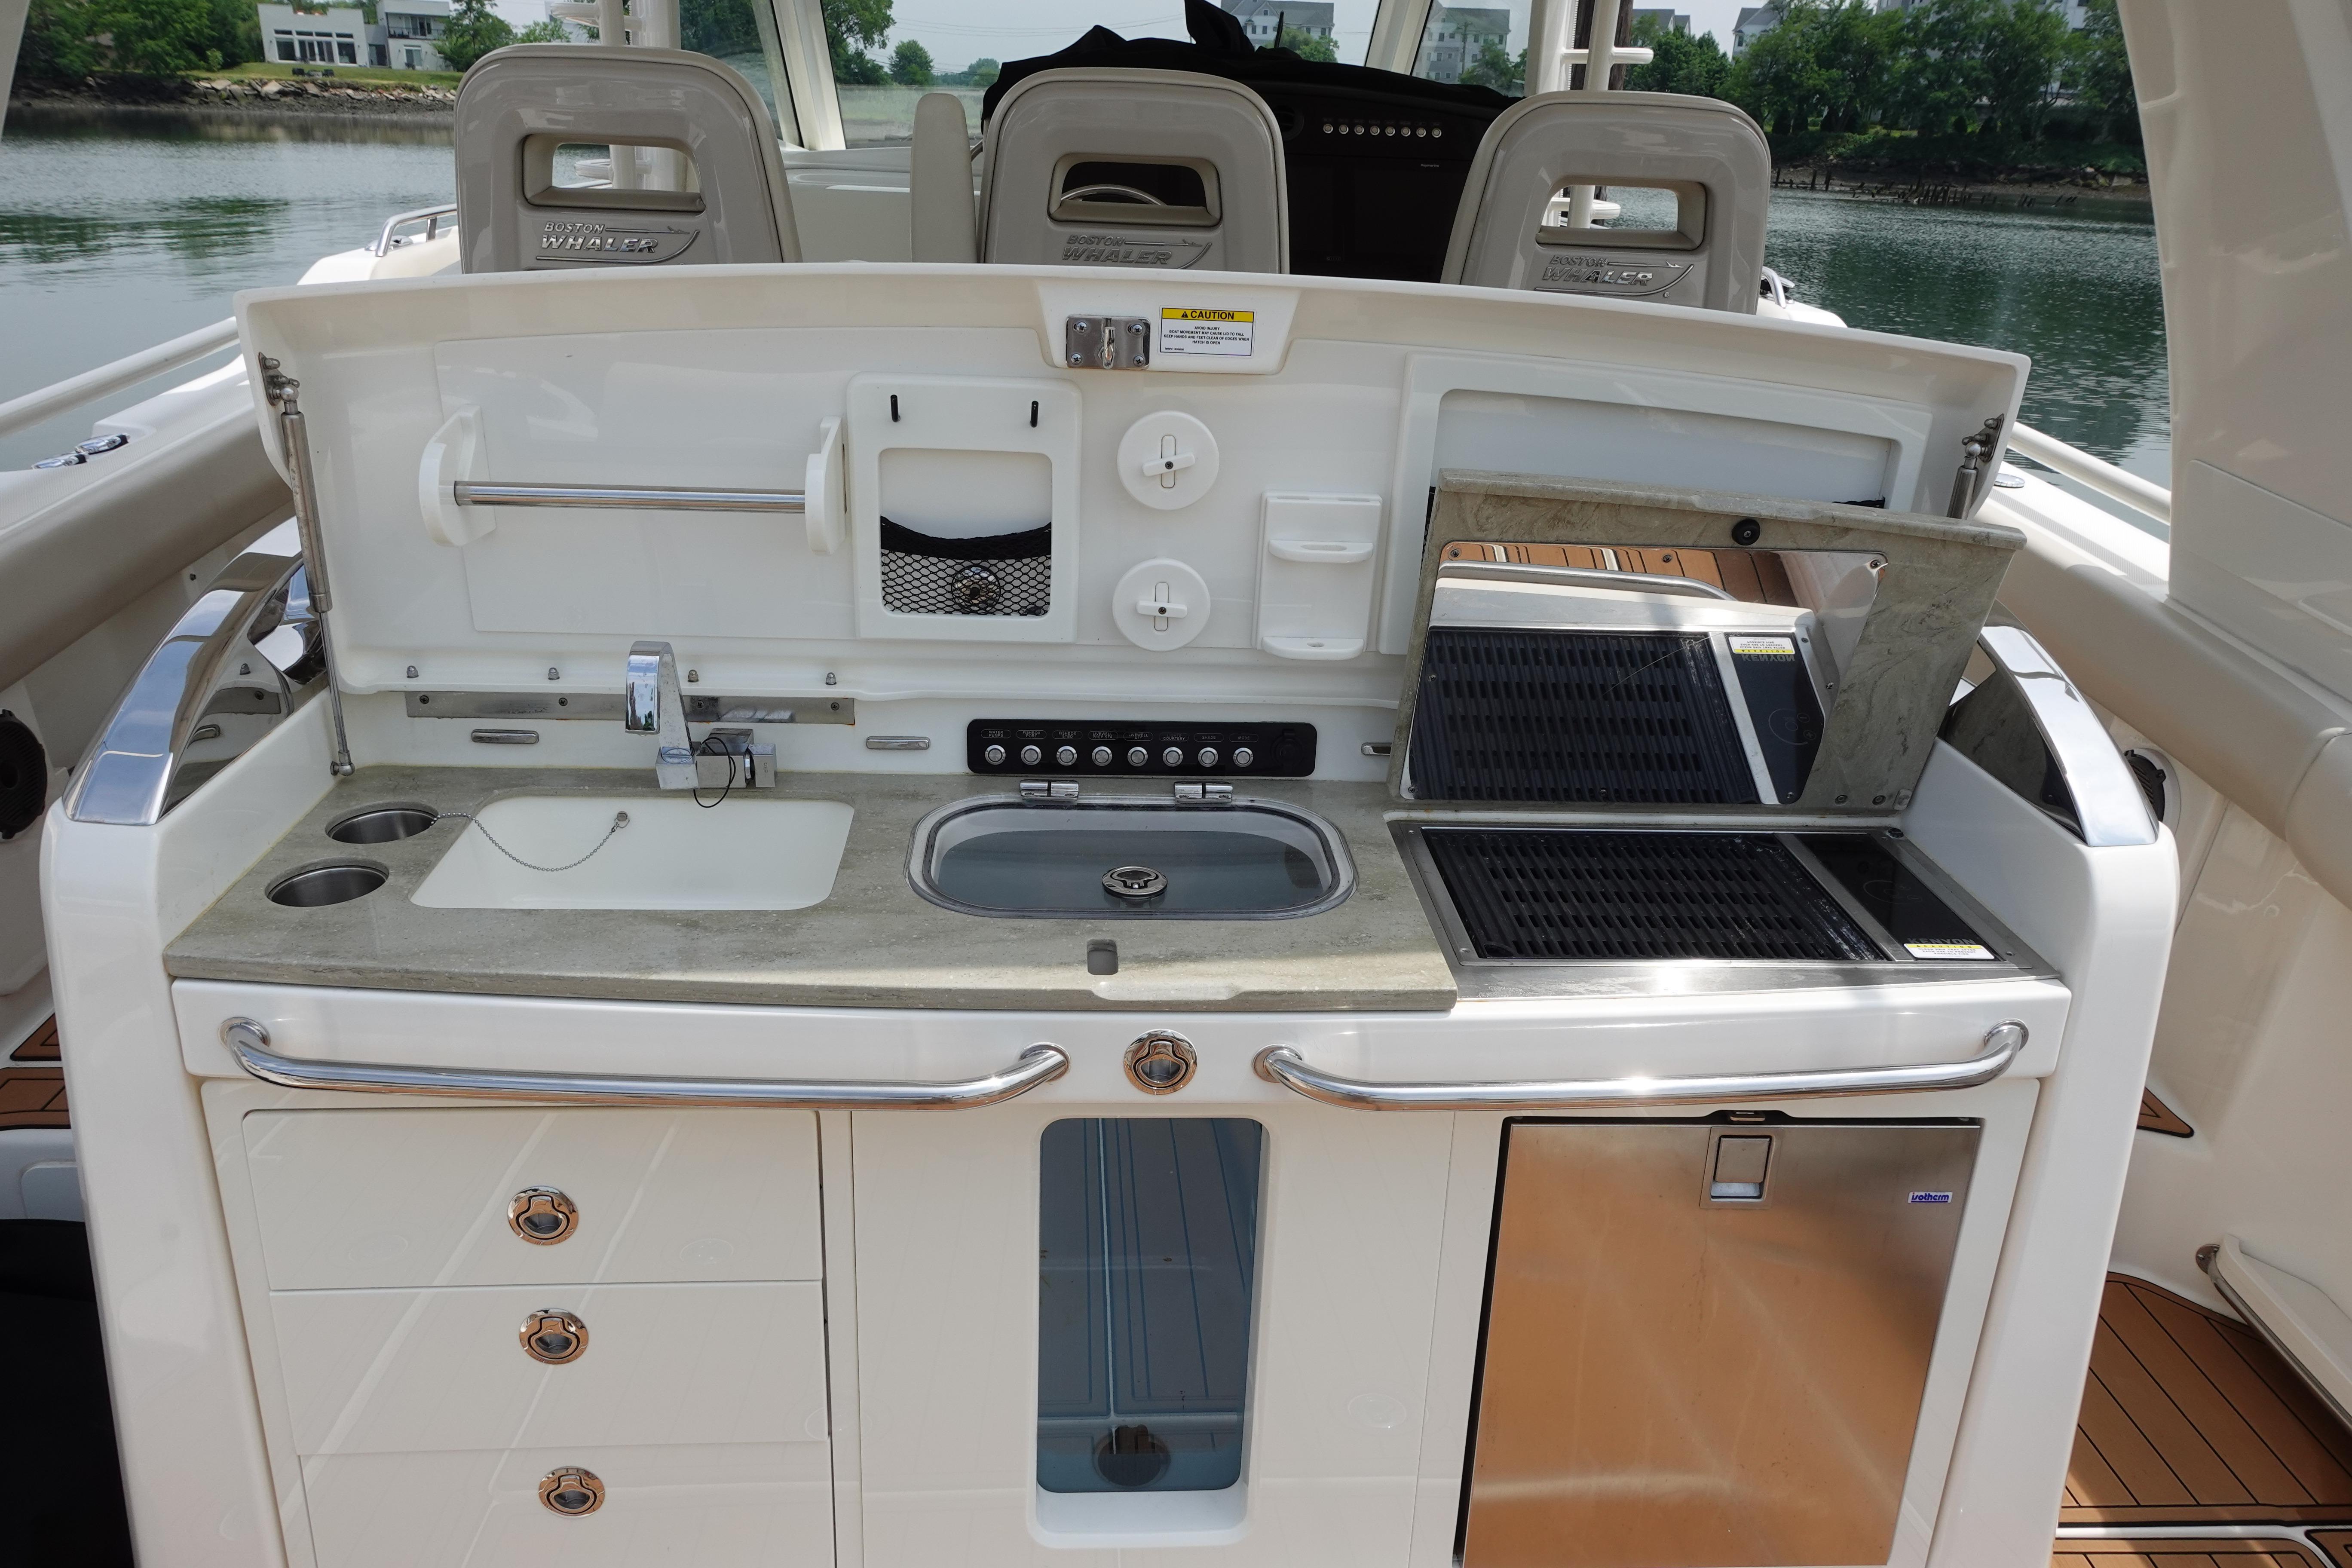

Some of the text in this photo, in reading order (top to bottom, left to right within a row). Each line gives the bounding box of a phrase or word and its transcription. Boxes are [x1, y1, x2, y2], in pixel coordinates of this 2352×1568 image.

[544, 221, 605, 234] BOSTON
[541, 234, 658, 253] WHALER
[1067, 234, 1126, 247] BOSTON
[1062, 246, 1172, 264] WHALER
[1550, 255, 1609, 267] BOSTON
[1542, 267, 1653, 286] WHALER
[1191, 310, 1234, 320] CAUTION
[1911, 1192, 1949, 1200] isotherm
